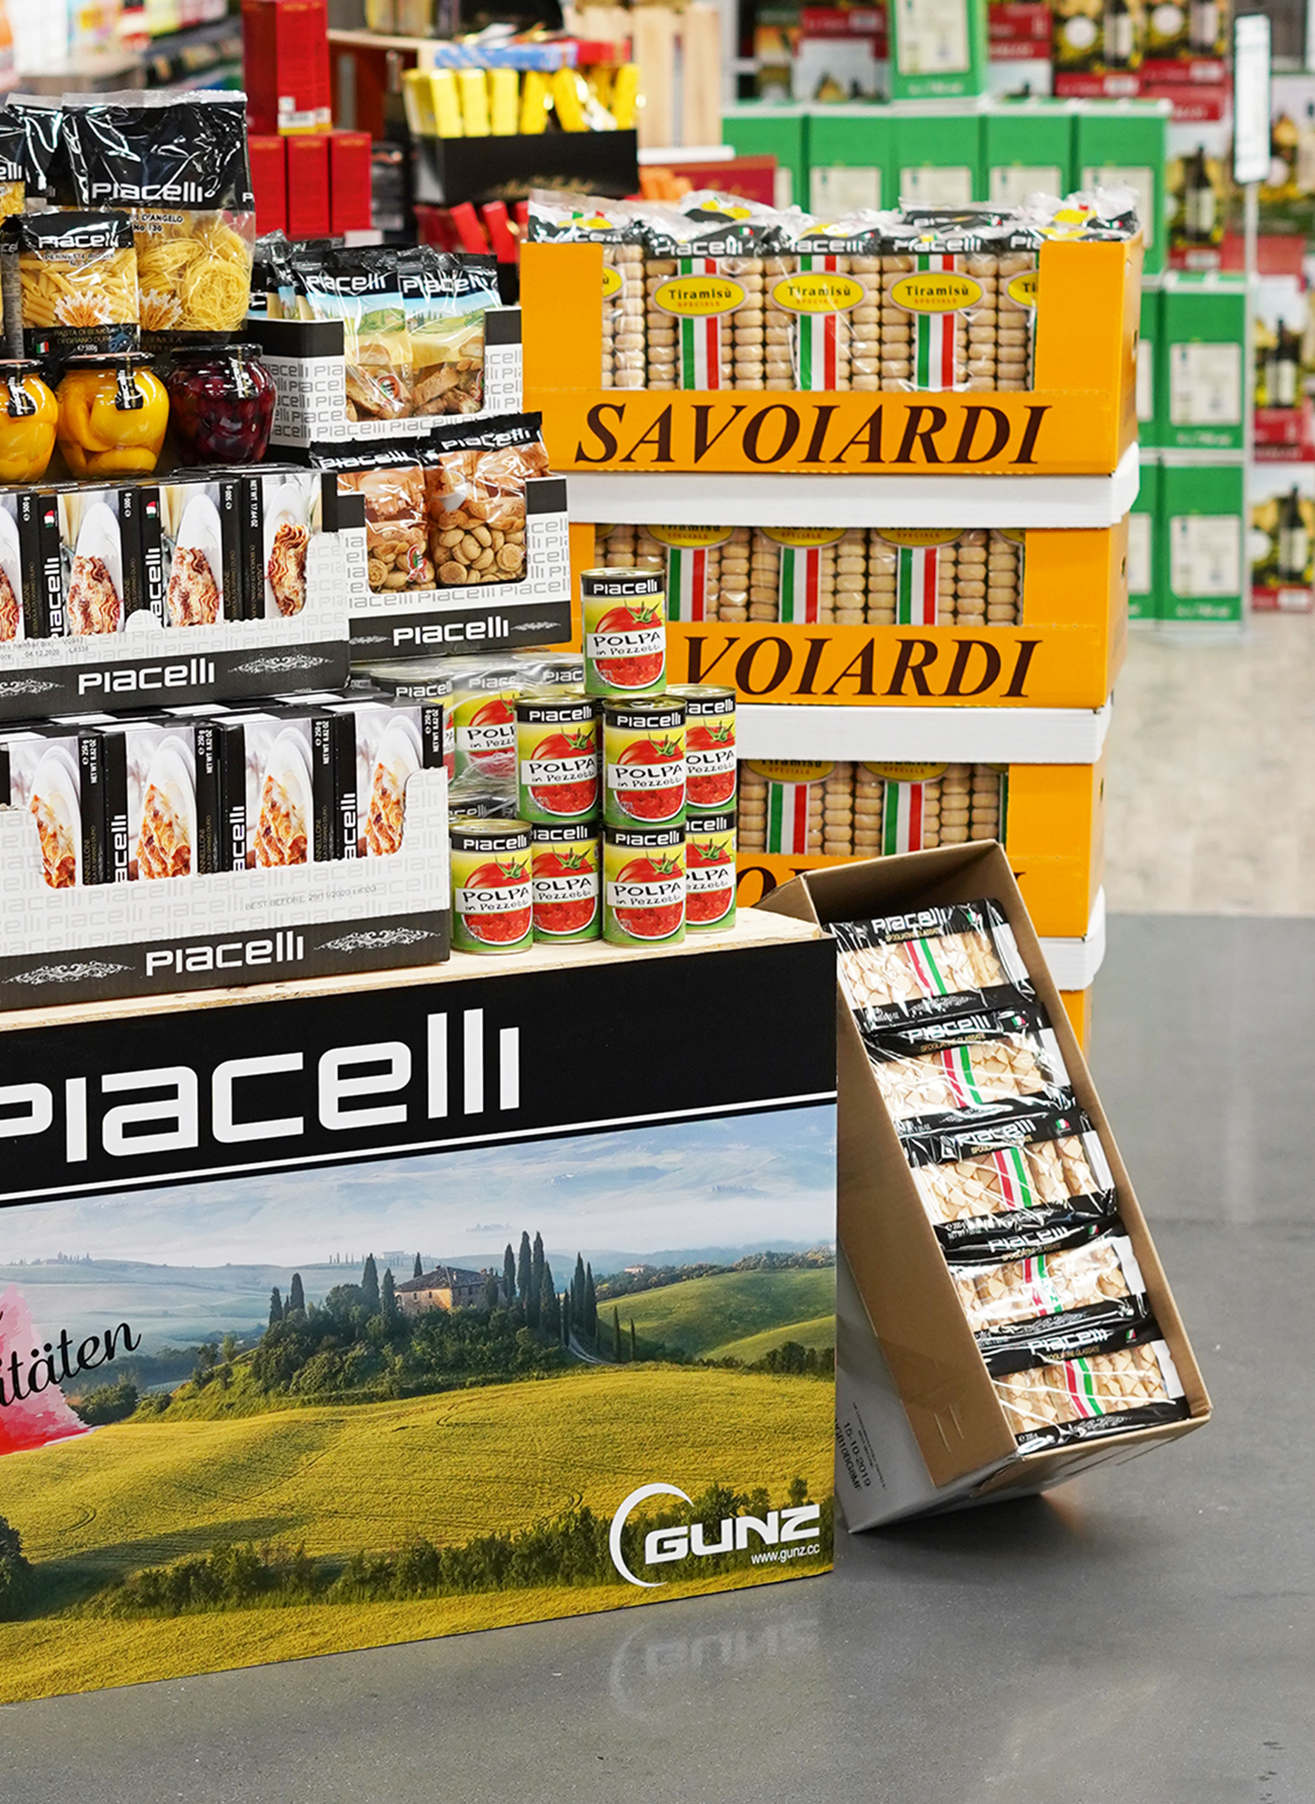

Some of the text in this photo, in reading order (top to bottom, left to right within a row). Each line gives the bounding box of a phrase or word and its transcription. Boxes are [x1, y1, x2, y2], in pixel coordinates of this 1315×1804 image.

[667, 286, 733, 300] Tiramisù
[786, 284, 852, 298] Tiramisù
[904, 283, 970, 297] Tiramisù
[573, 403, 1054, 464] SAVOIARDI
[593, 630, 661, 649] POLPA
[595, 647, 608, 657] in
[683, 635, 1044, 698] VOIARDI
[528, 757, 596, 775] POLPA
[615, 763, 682, 780] POLPA
[530, 775, 544, 785] in
[617, 779, 630, 789] in
[83, 839, 91, 885] ANNELLONI
[461, 885, 530, 903] POLPA
[614, 882, 682, 899] POLPA
[463, 903, 478, 912] in
[616, 897, 629, 907] in
[843, 1421, 872, 1488] 15-10-2019
[644, 1503, 821, 1565] GUNZ
[750, 1543, 821, 1566] www.gunz.cc
